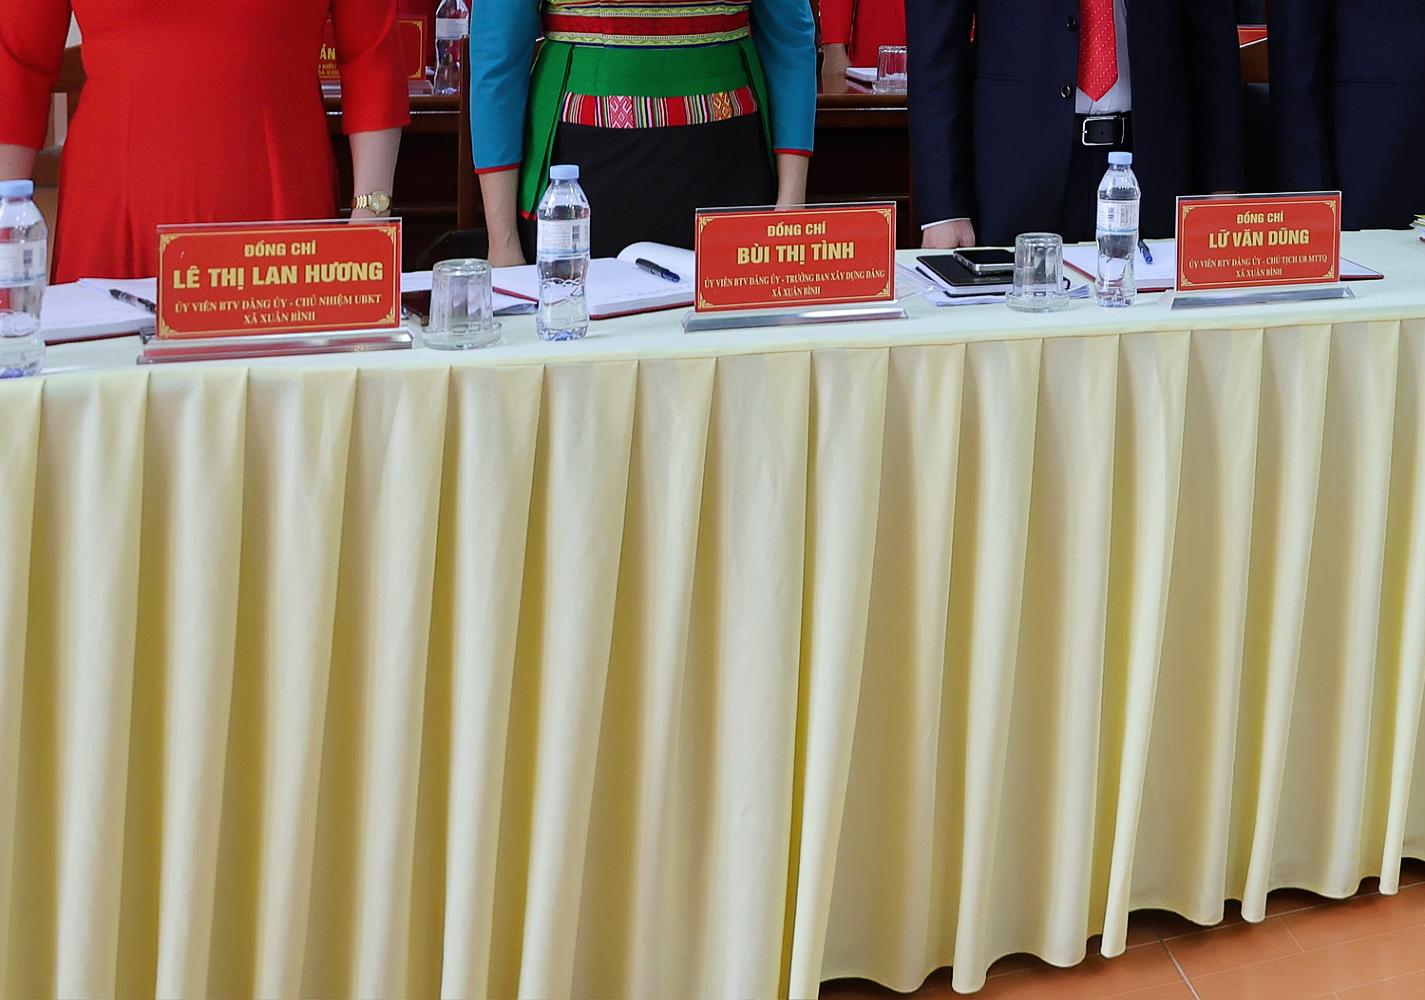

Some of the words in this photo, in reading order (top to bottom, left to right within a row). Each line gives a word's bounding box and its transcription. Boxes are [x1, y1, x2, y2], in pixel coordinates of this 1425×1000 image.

[1267, 210, 1284, 222] CHÍ
[767, 221, 801, 237] ĐỒNG
[805, 221, 826, 235] CHÍ
[1209, 229, 1230, 248] LỮ
[1232, 229, 1263, 247] VĂN
[1268, 227, 1309, 245] DŨNG
[244, 240, 286, 257] ĐỒNG
[291, 240, 316, 255] CHÍ
[738, 243, 770, 265] BÙI
[776, 244, 805, 265] THỊ
[811, 240, 854, 260] TÌNH
[1200, 258, 1218, 268] VIÊN
[1218, 259, 1231, 267] BTV
[1282, 256, 1298, 266] TỊCH
[173, 265, 200, 289] LÊ
[208, 267, 244, 290] THỊ
[253, 265, 297, 285] LAN
[305, 261, 383, 283] HƯƠNG
[716, 275, 733, 288] VIÊN
[734, 276, 749, 286] BTV
[815, 272, 830, 282] BAN
[831, 270, 845, 281] XÂY
[846, 270, 865, 282] DỰNG
[1236, 268, 1246, 277] XÃ
[1246, 268, 1266, 277] XUÂN
[1266, 267, 1282, 276] BÌNH
[772, 287, 782, 297] XÃ
[783, 286, 803, 297] XUÂN
[804, 286, 821, 296] BÌNH
[174, 302, 189, 313] ỦY
[192, 300, 217, 312] VIÊN
[219, 301, 241, 311] BTV
[273, 296, 288, 309] ỦY
[295, 294, 317, 308] CHỦ
[319, 294, 352, 308] NHIỆM
[355, 294, 381, 304] UBKT
[244, 313, 258, 324] XÃ
[261, 312, 289, 324] XUÂN
[291, 311, 316, 322] BÌNH
